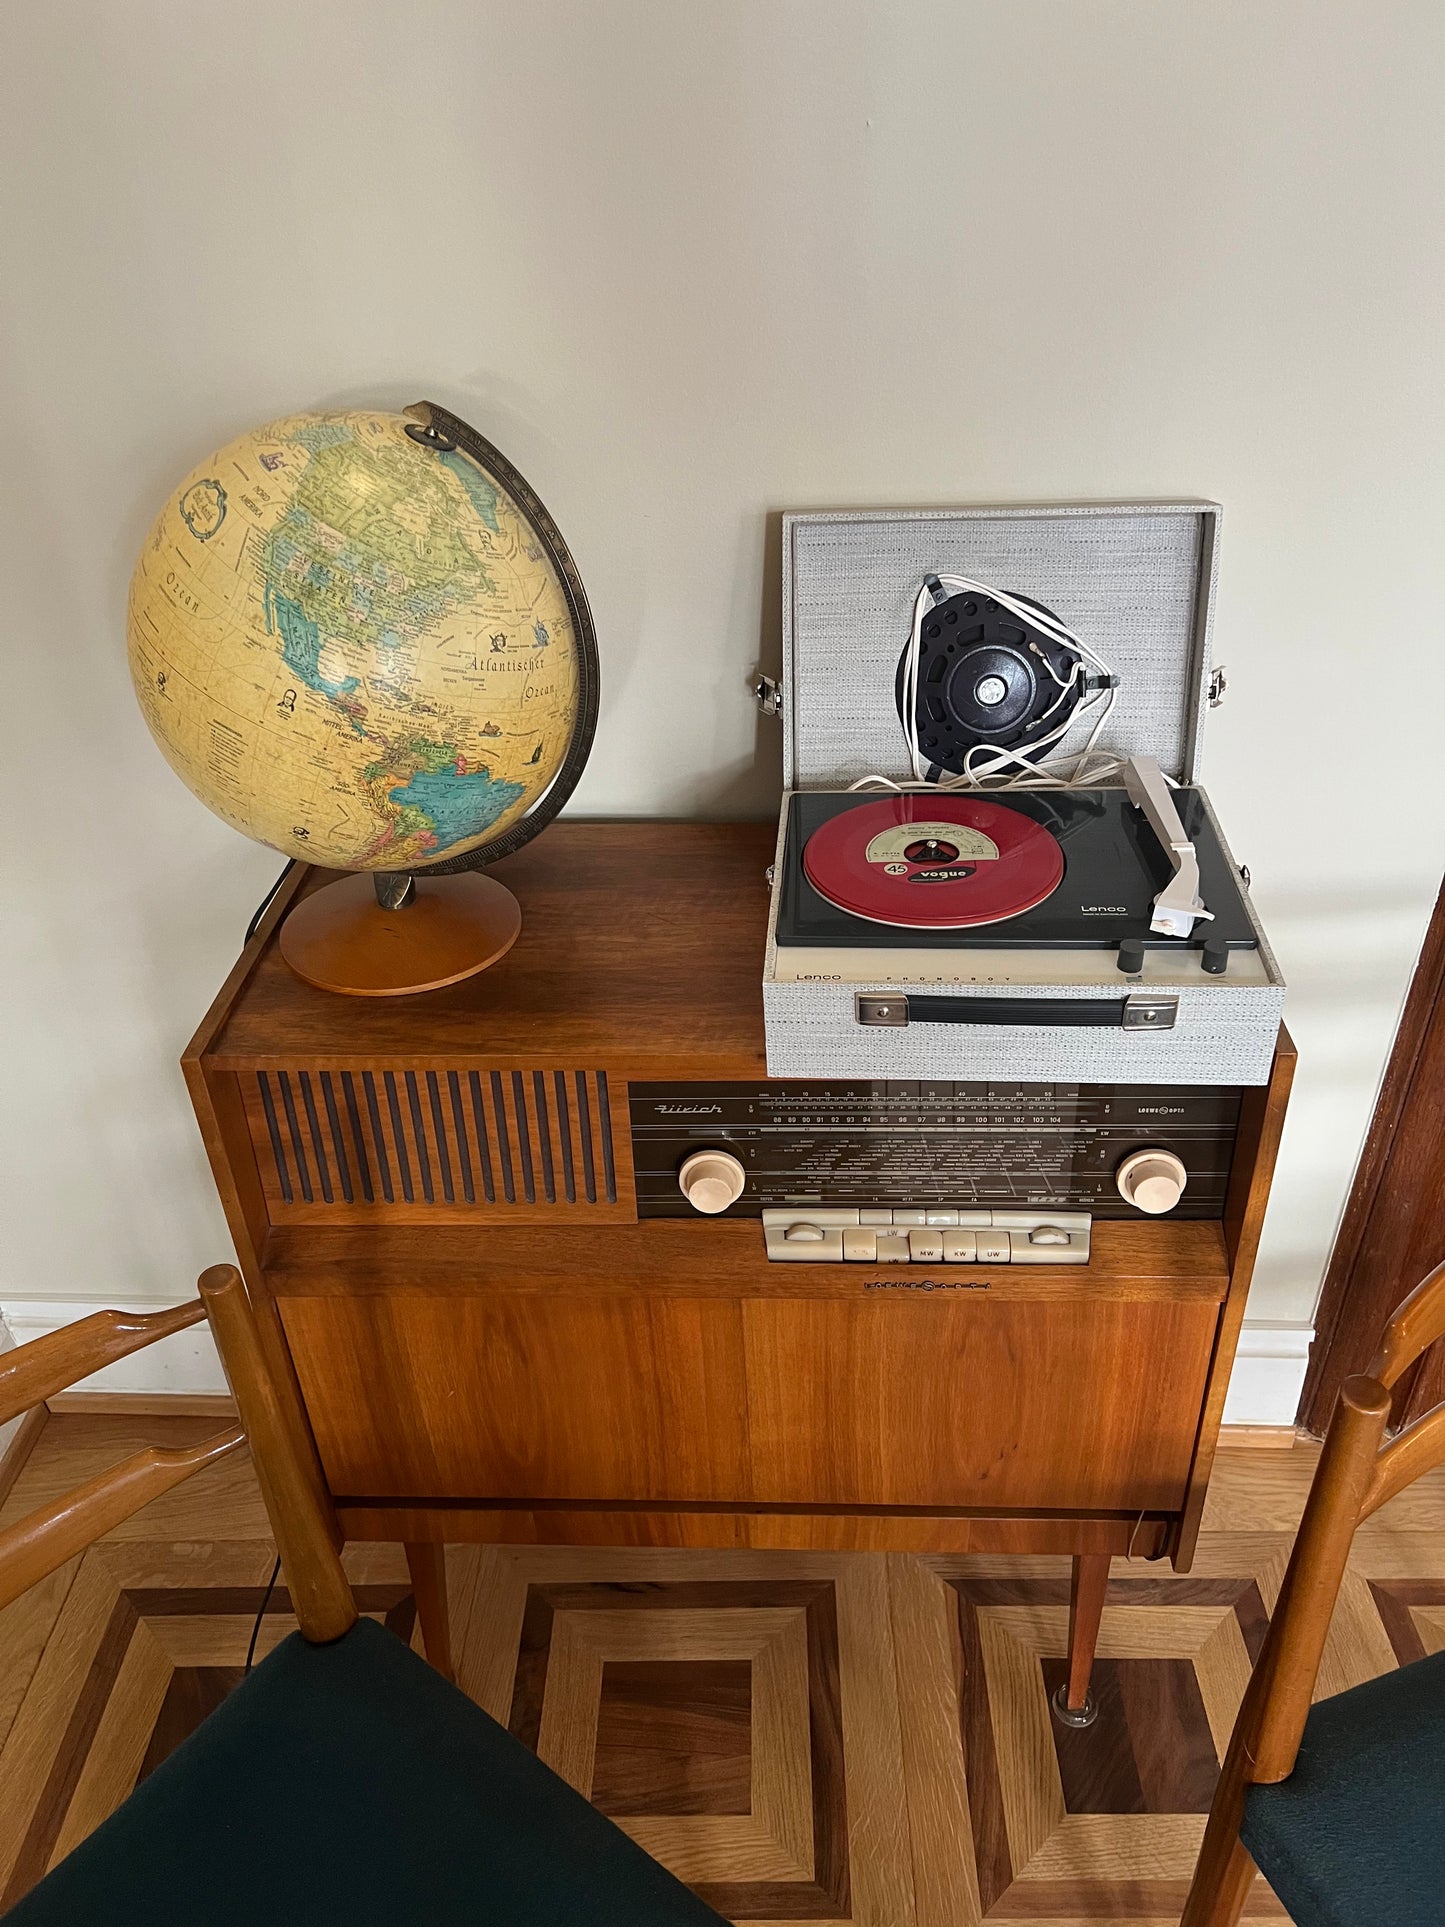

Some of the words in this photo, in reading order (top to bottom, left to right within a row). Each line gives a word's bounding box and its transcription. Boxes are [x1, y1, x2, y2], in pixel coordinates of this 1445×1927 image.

[166, 571, 199, 613] Ozean
[465, 656, 544, 674] Atlantischer
[525, 684, 555, 699] Ozean
[887, 865, 906, 873] 45
[920, 869, 967, 879] vogue
